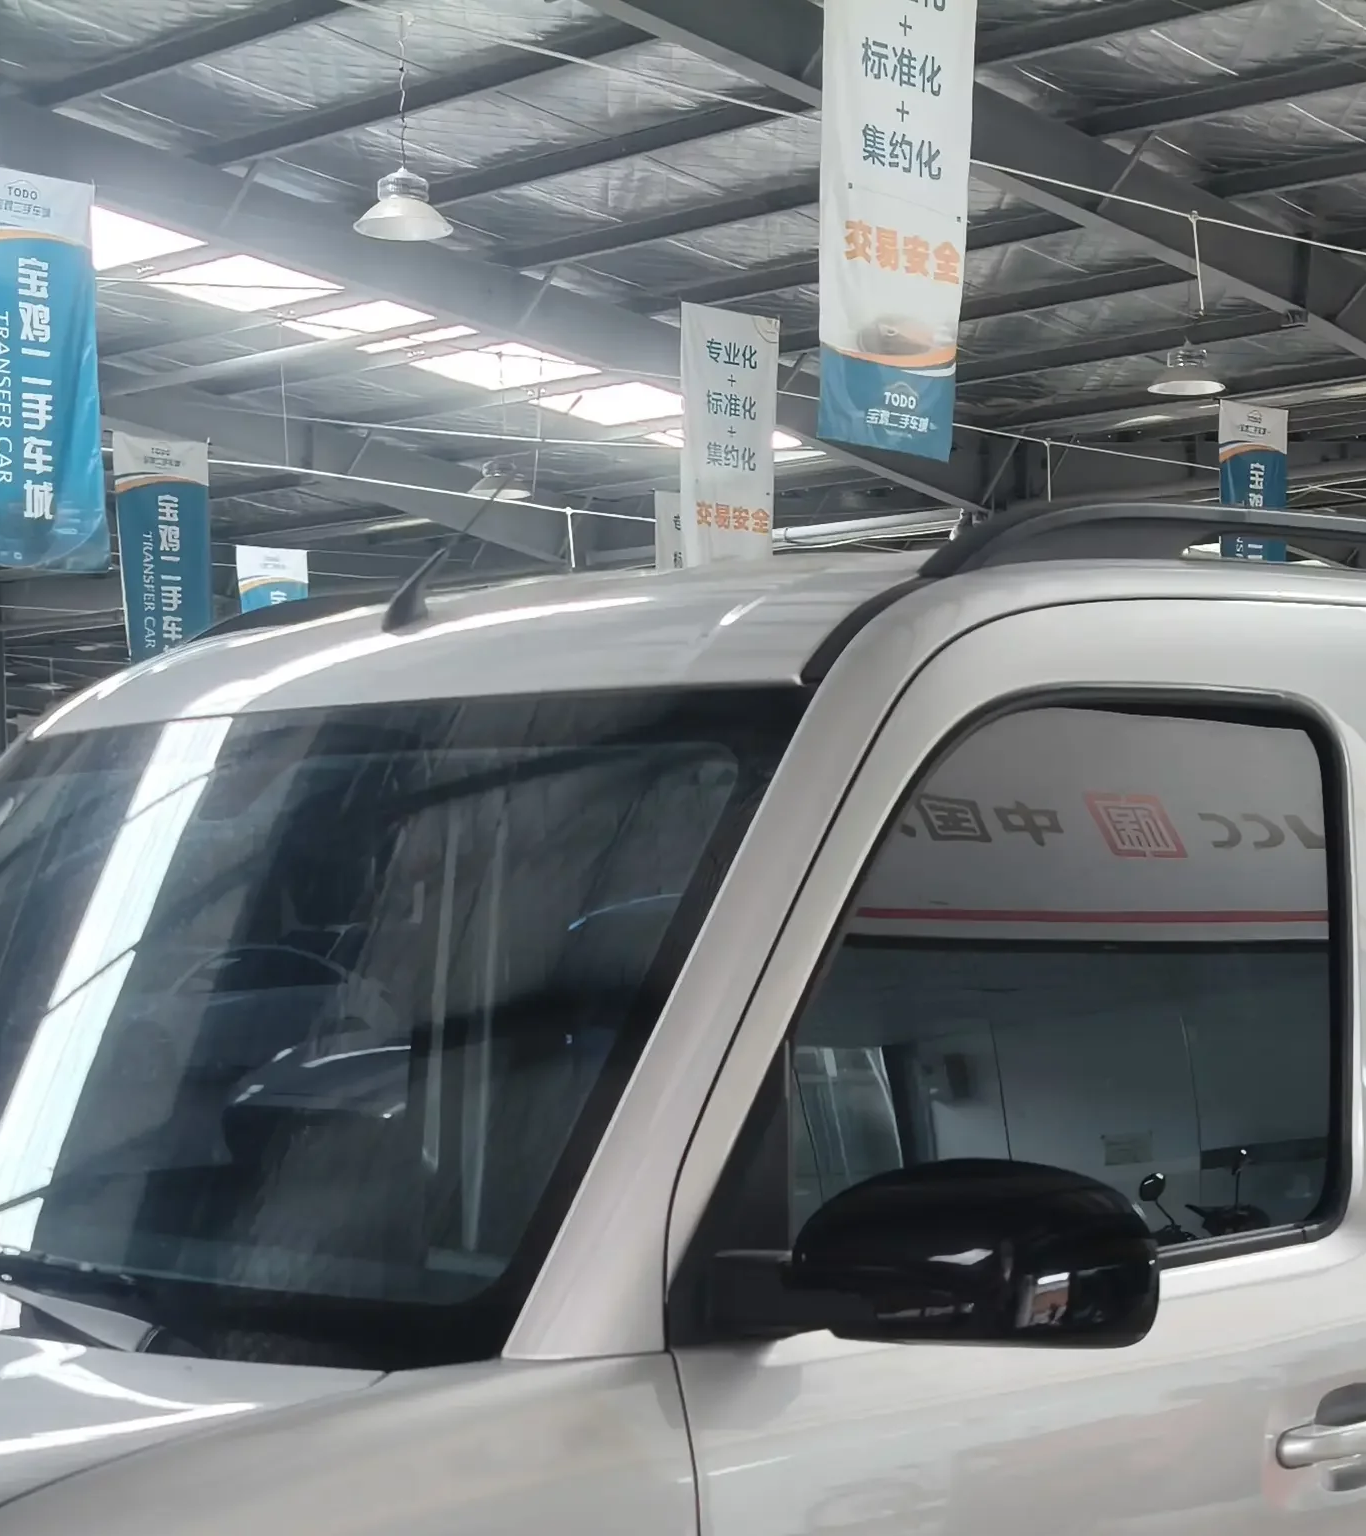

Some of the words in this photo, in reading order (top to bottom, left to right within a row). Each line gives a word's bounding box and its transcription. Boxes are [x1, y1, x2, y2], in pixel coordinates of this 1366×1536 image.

[861, 38, 942, 96] 标准化
[861, 124, 942, 180] 集约化
[7, 186, 38, 200] TODO
[844, 218, 961, 285] 交易安全
[706, 338, 757, 370] 专业化
[18, 257, 55, 520] 宝鸡二手车城
[884, 391, 916, 409] TODO
[706, 390, 757, 421] 标准化
[706, 442, 757, 472] 集约化
[695, 501, 770, 534] 交易安全
[142, 530, 155, 611] TRANSFER
[158, 494, 183, 652] 宝鸡二手车
[143, 617, 157, 648] CAR
